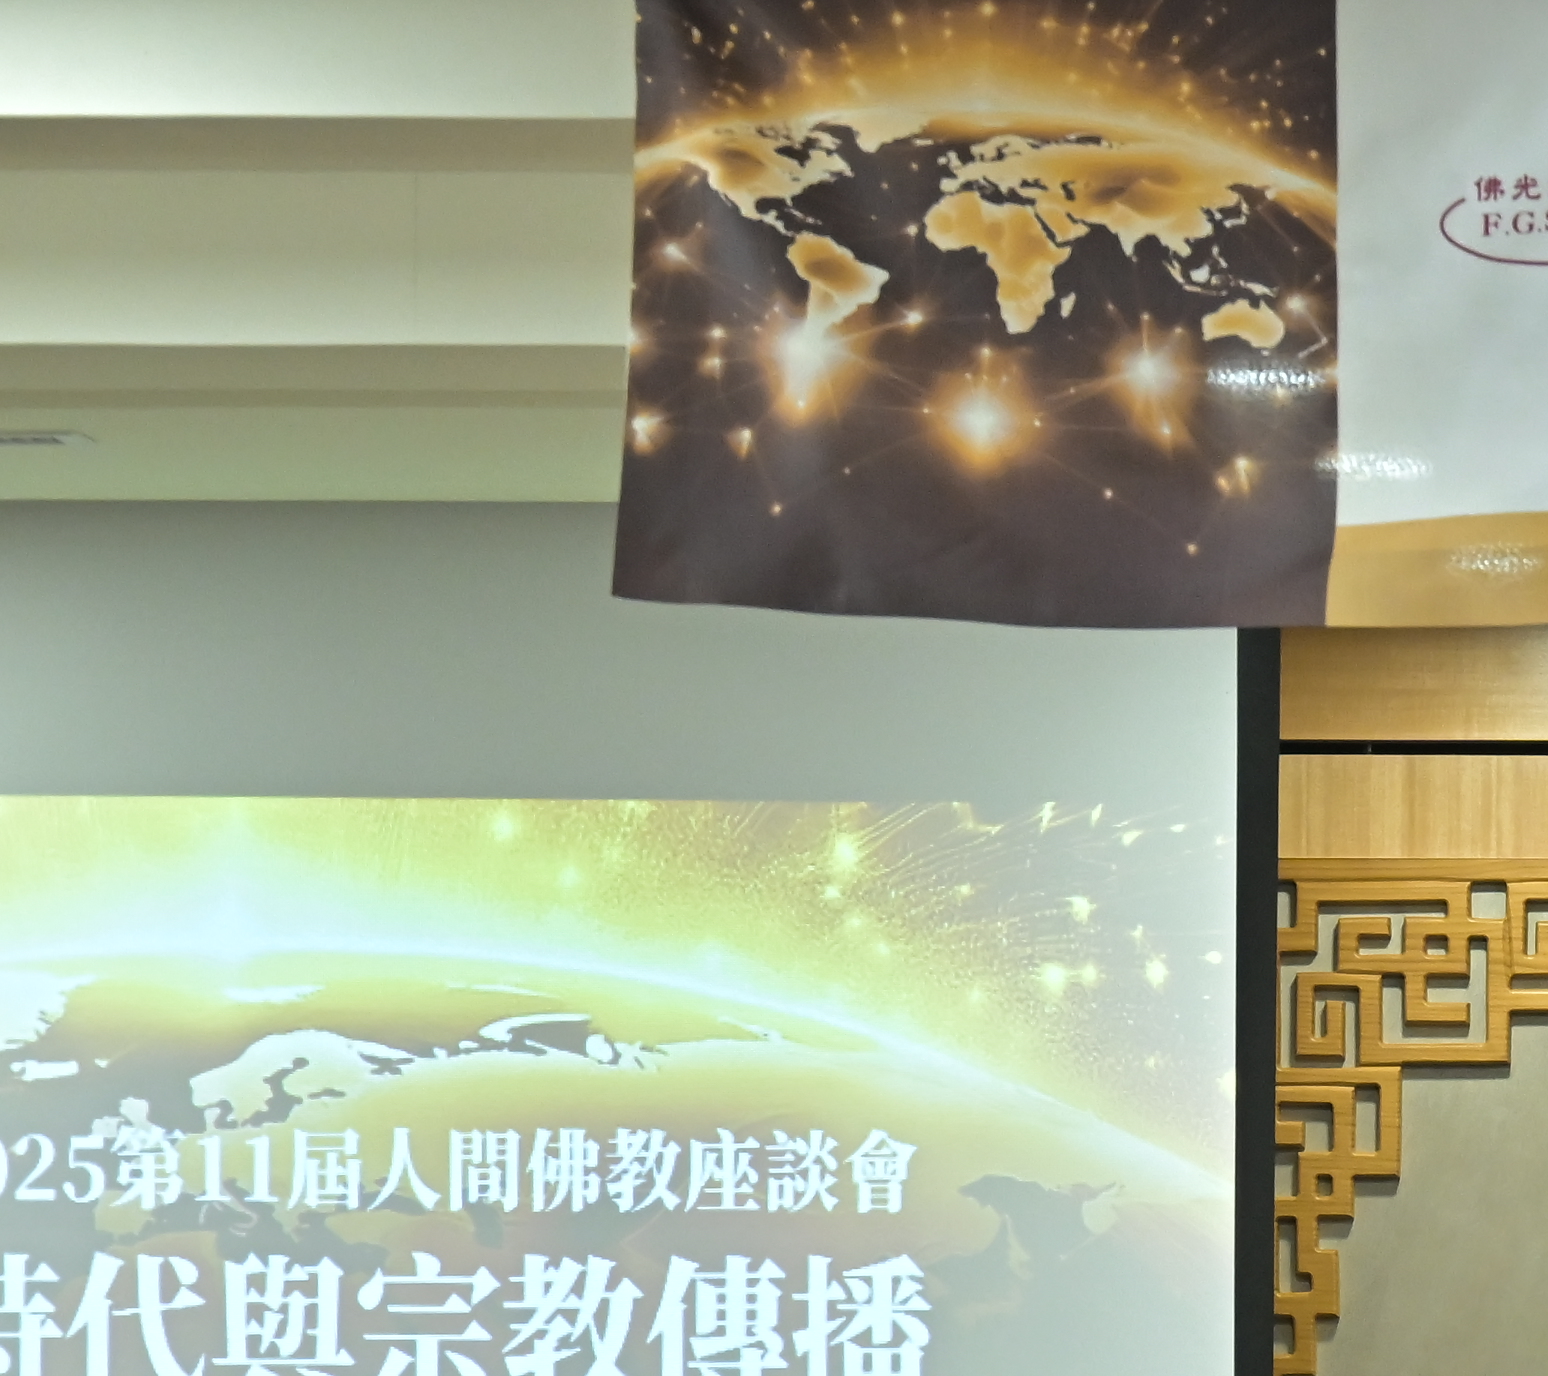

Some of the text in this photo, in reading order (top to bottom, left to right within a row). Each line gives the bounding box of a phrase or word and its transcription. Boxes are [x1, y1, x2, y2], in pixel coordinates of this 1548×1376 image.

[0, 1128, 917, 1215] 25第11屆人間佛教座談會
